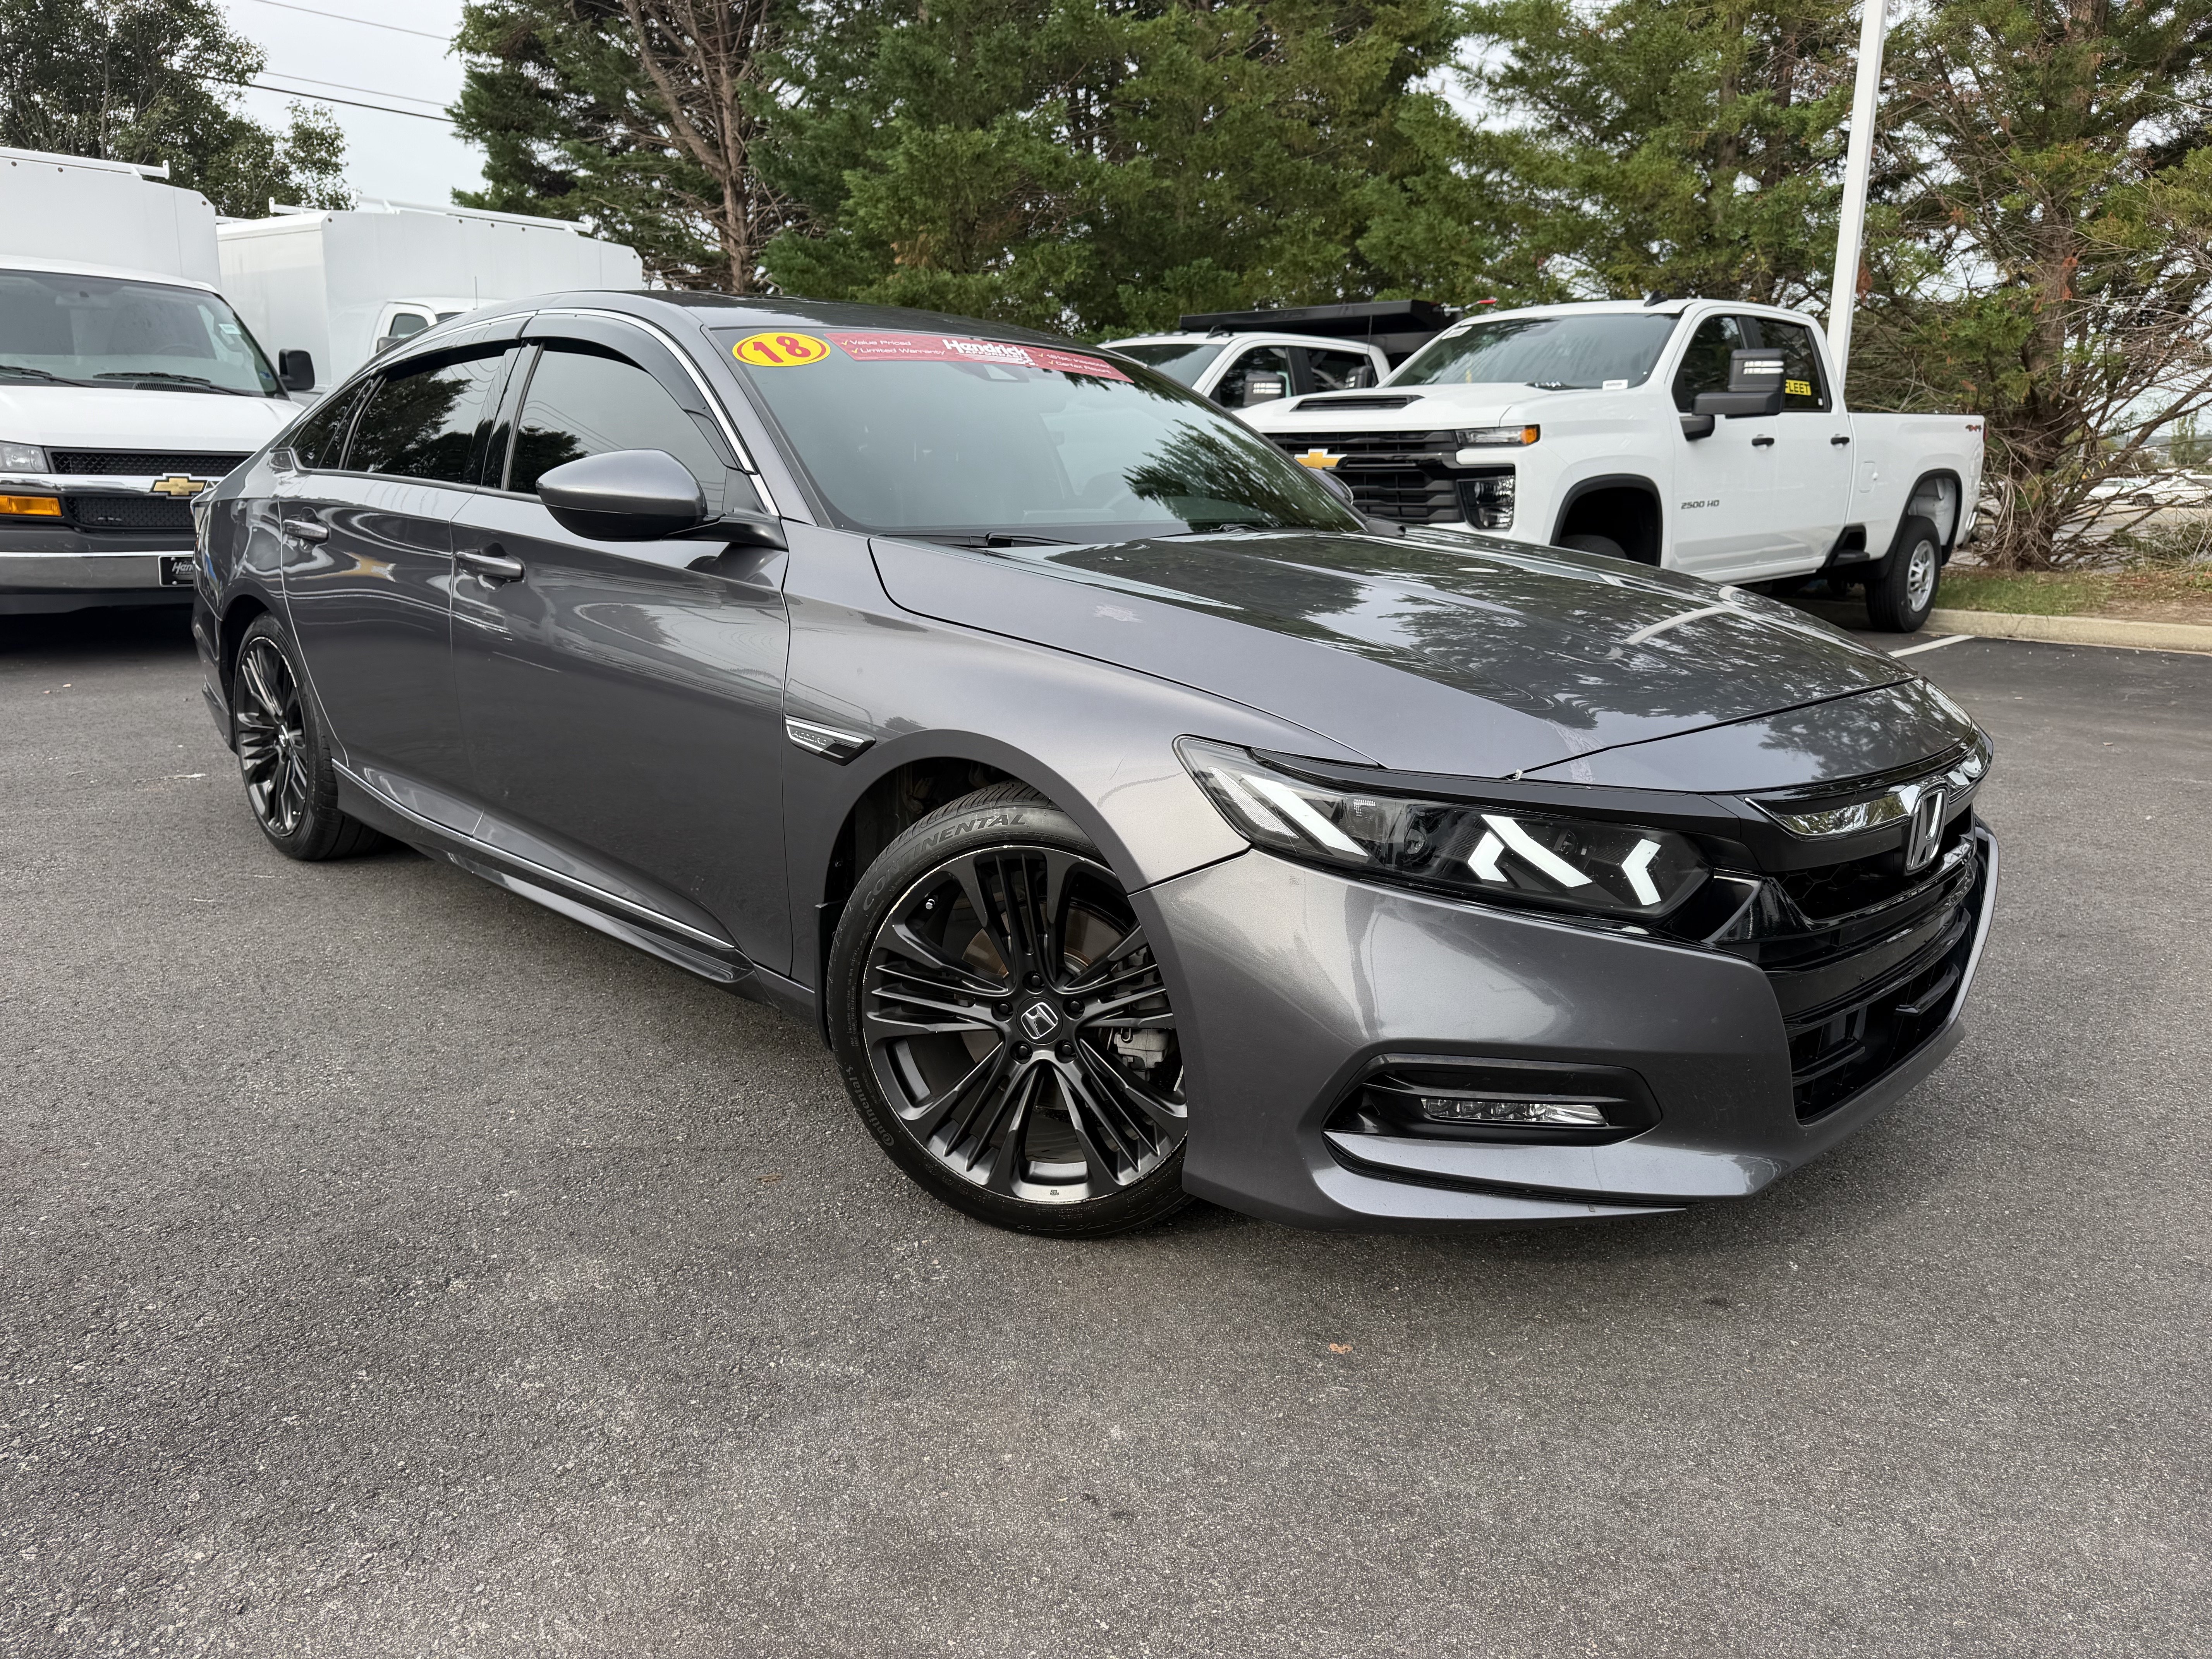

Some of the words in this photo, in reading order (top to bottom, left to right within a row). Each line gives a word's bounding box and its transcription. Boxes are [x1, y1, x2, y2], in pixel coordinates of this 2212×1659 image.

[752, 336, 811, 363] 18
[942, 339, 1028, 357] Hendrick
[1681, 501, 1705, 510] 2500
[792, 730, 827, 746] ACCORD
[863, 814, 1025, 911] CONTINENTAL
[848, 1076, 895, 1147] Continental
